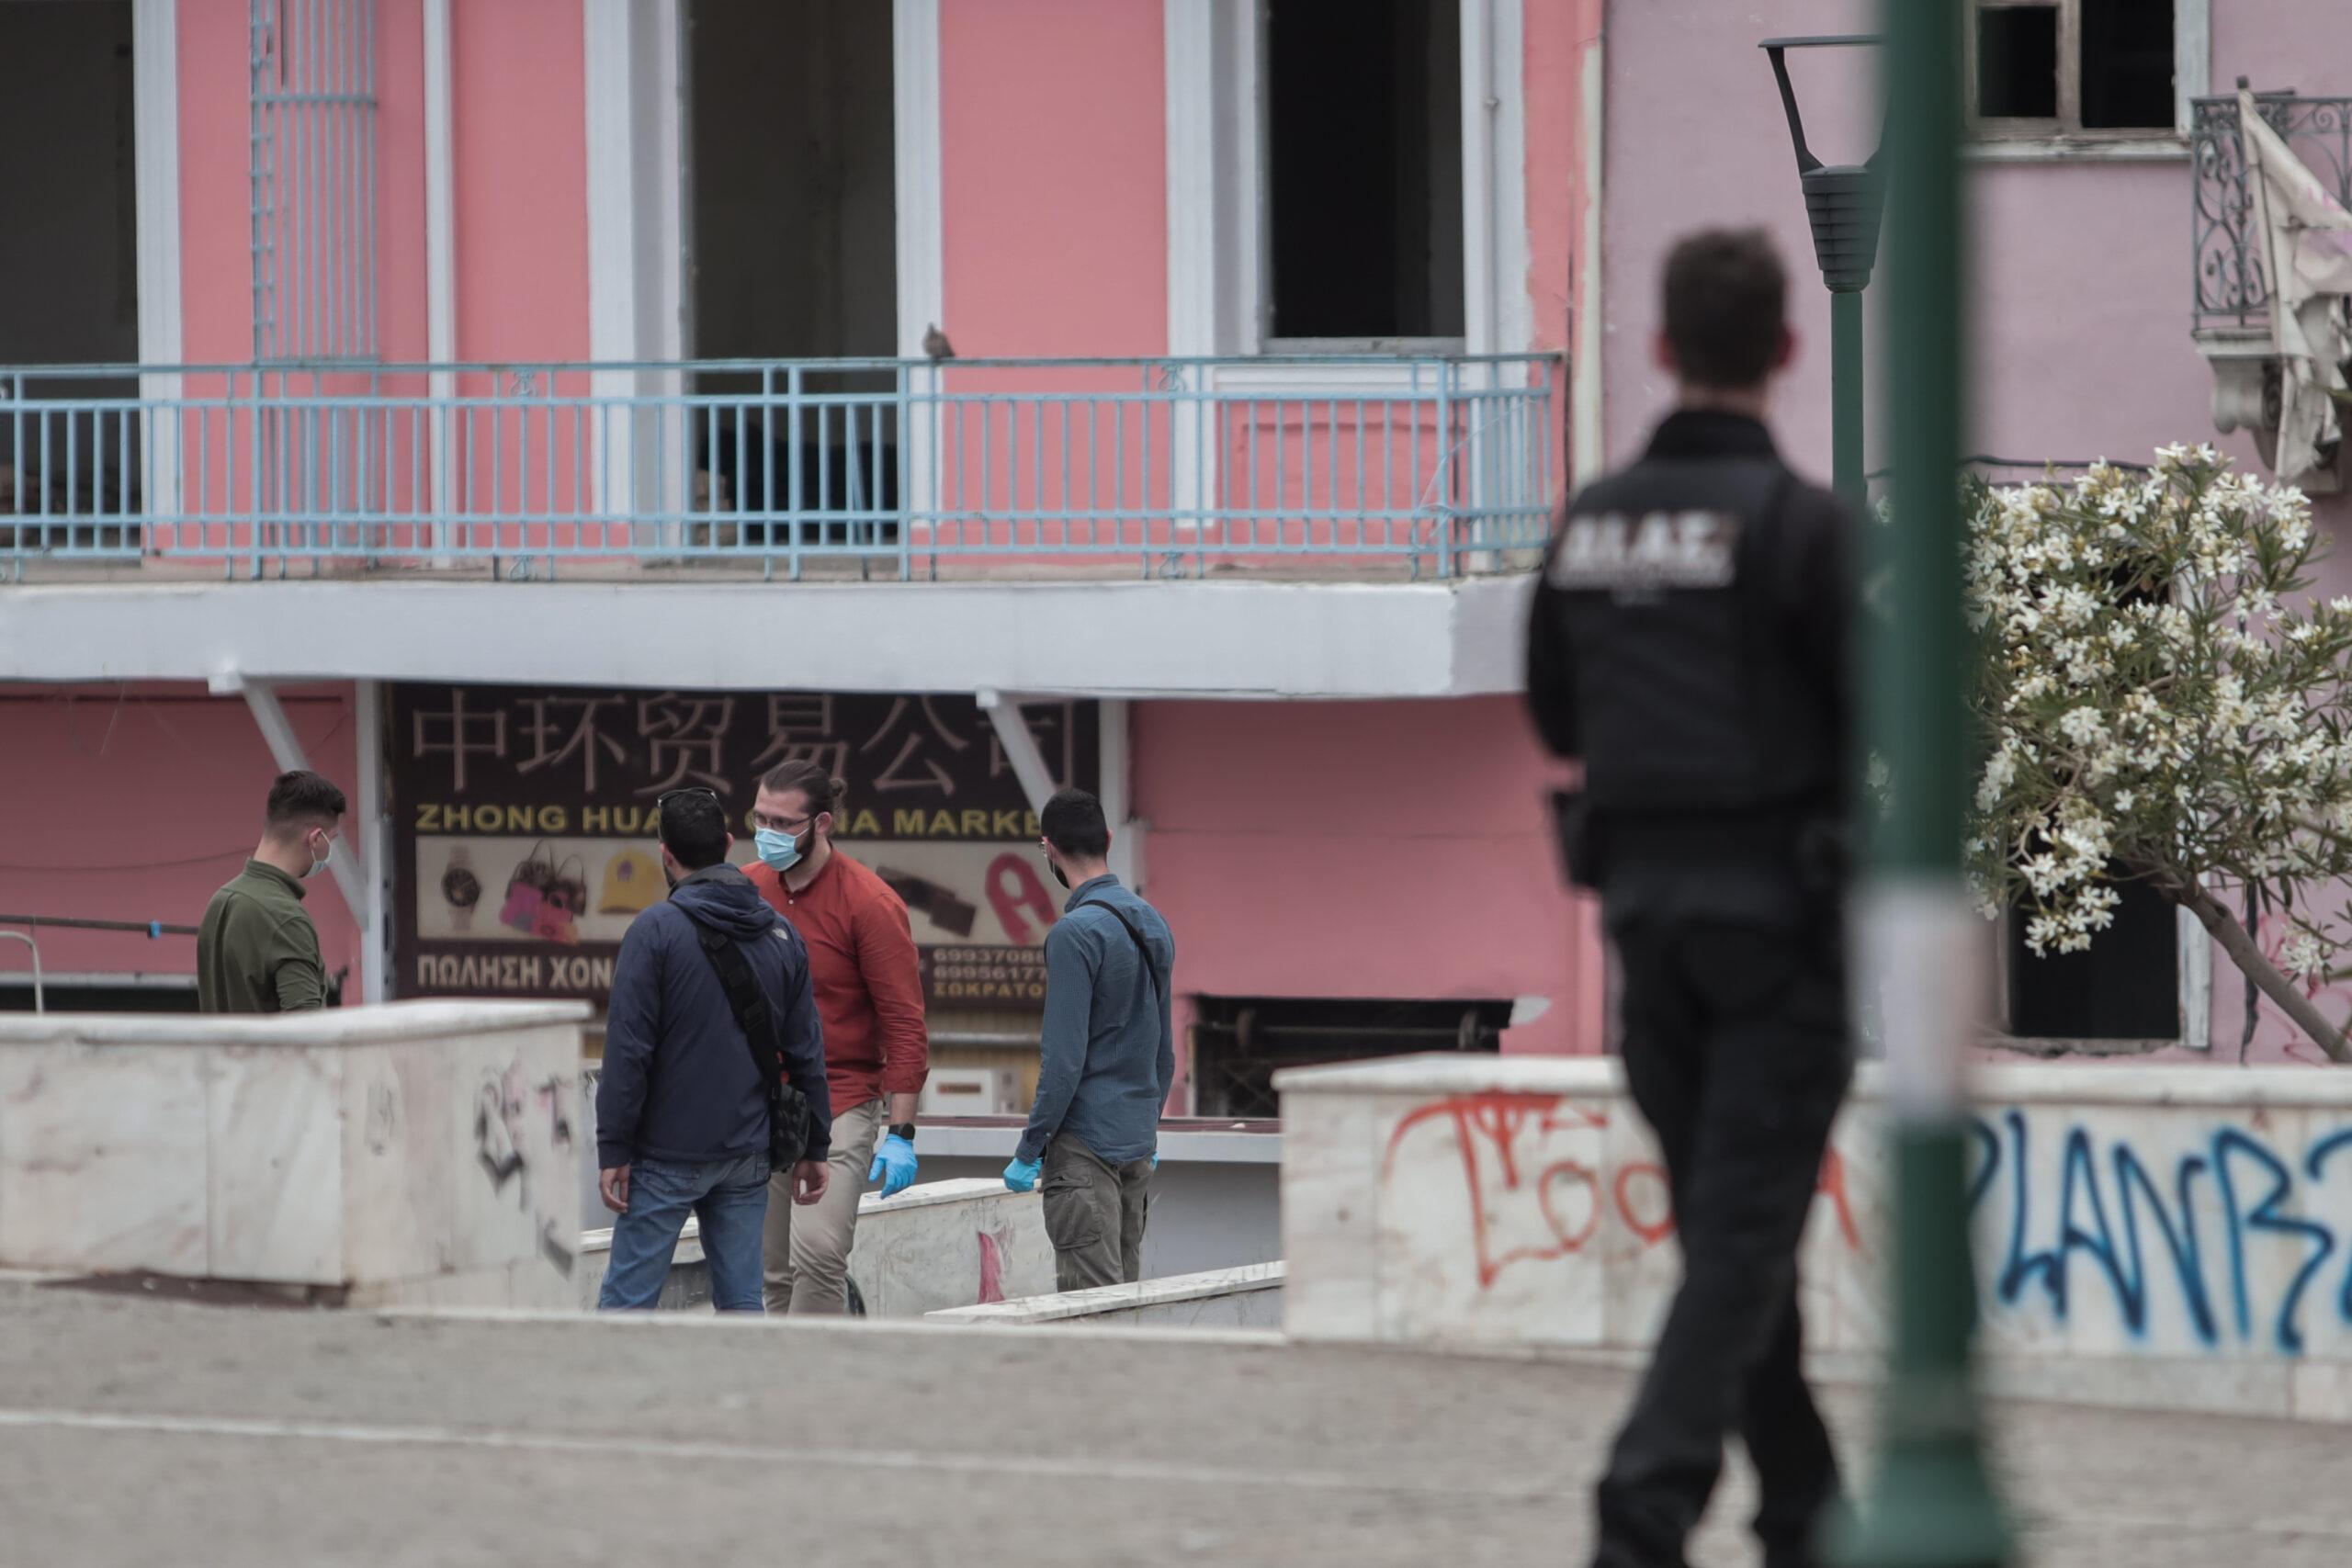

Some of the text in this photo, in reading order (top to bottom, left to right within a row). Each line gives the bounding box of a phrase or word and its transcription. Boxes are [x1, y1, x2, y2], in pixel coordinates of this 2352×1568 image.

[413, 689, 1074, 795] 中环贸易公司
[415, 803, 568, 833] ZHONG
[893, 807, 1044, 837] MARKE
[416, 953, 614, 989] ΠΩΛΗΣΗ ΧΟΝ
[933, 964, 1047, 981] 69956177
[933, 981, 1046, 998] ΣΩΚΡΑΤΟ
